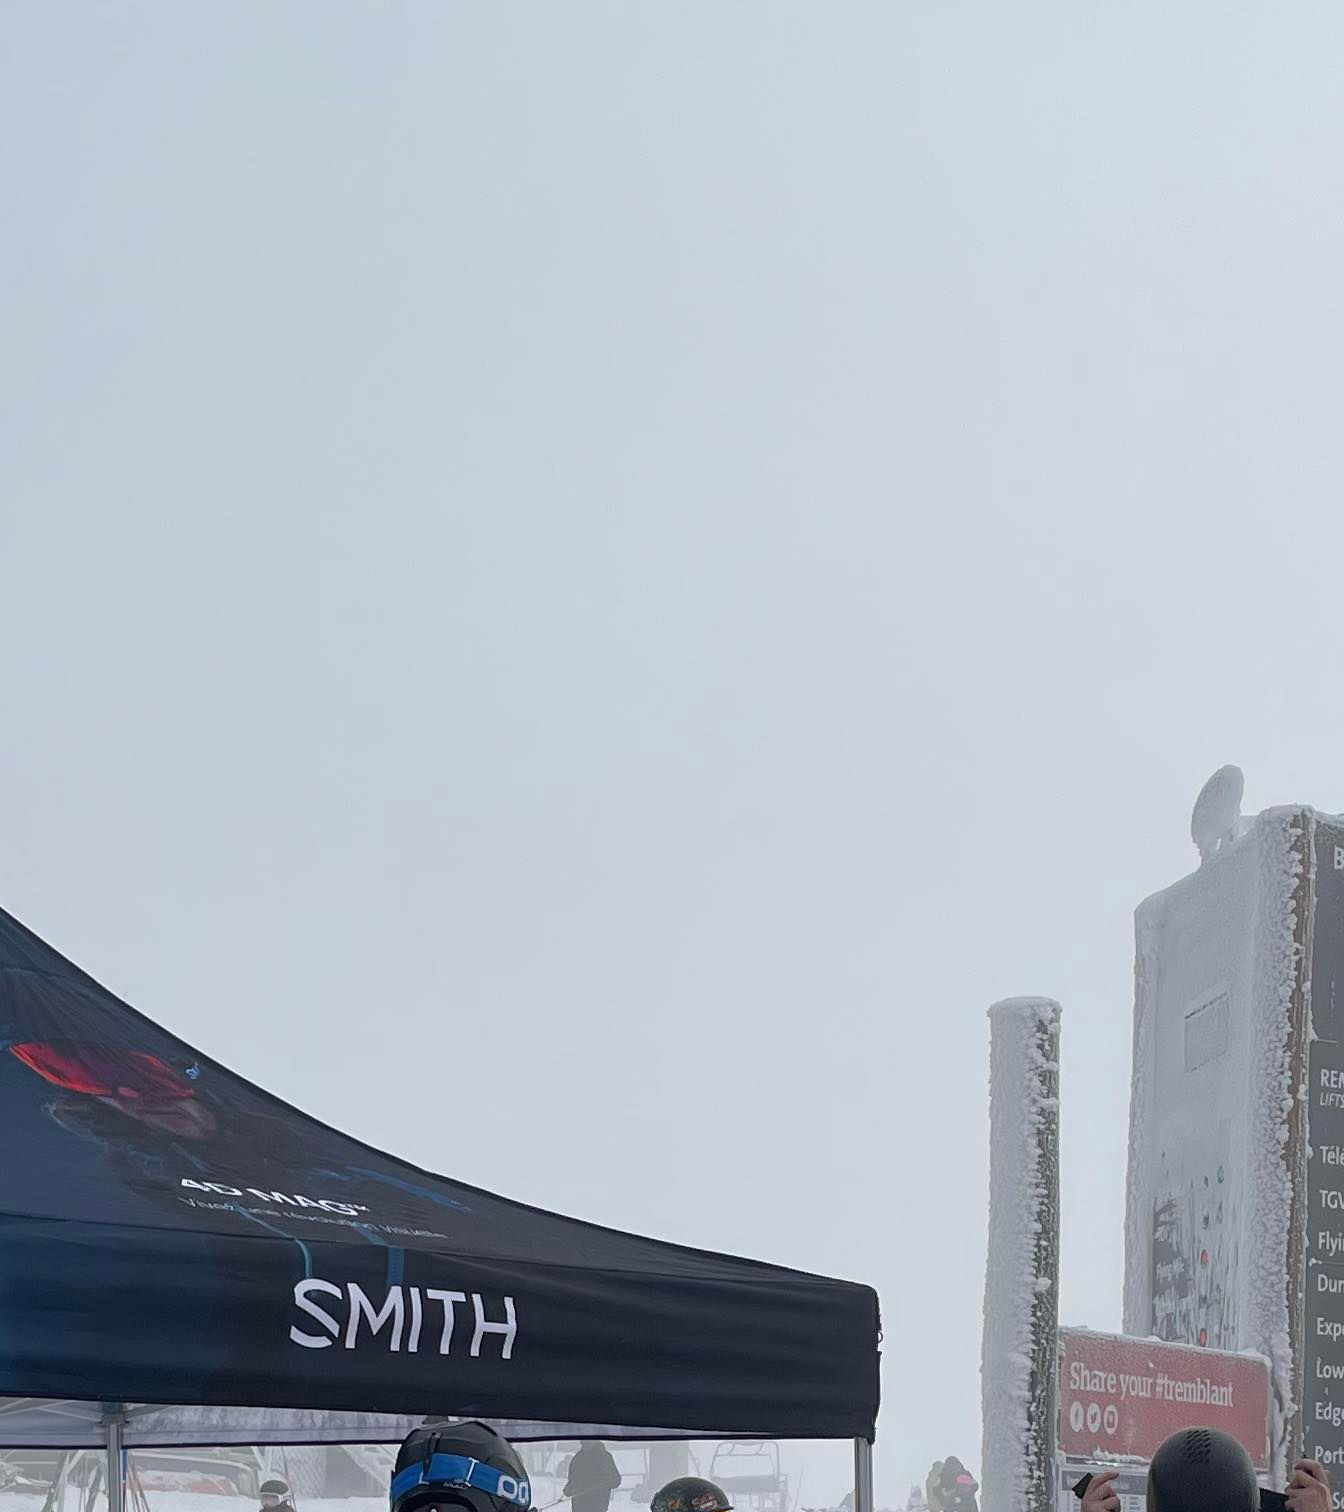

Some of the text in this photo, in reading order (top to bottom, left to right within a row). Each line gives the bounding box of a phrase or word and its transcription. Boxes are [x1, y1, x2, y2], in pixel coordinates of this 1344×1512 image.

[181, 1178, 243, 1197] 4D
[290, 1277, 518, 1360] SMITH
[1069, 1361, 1234, 1408] Share your #tremblant
